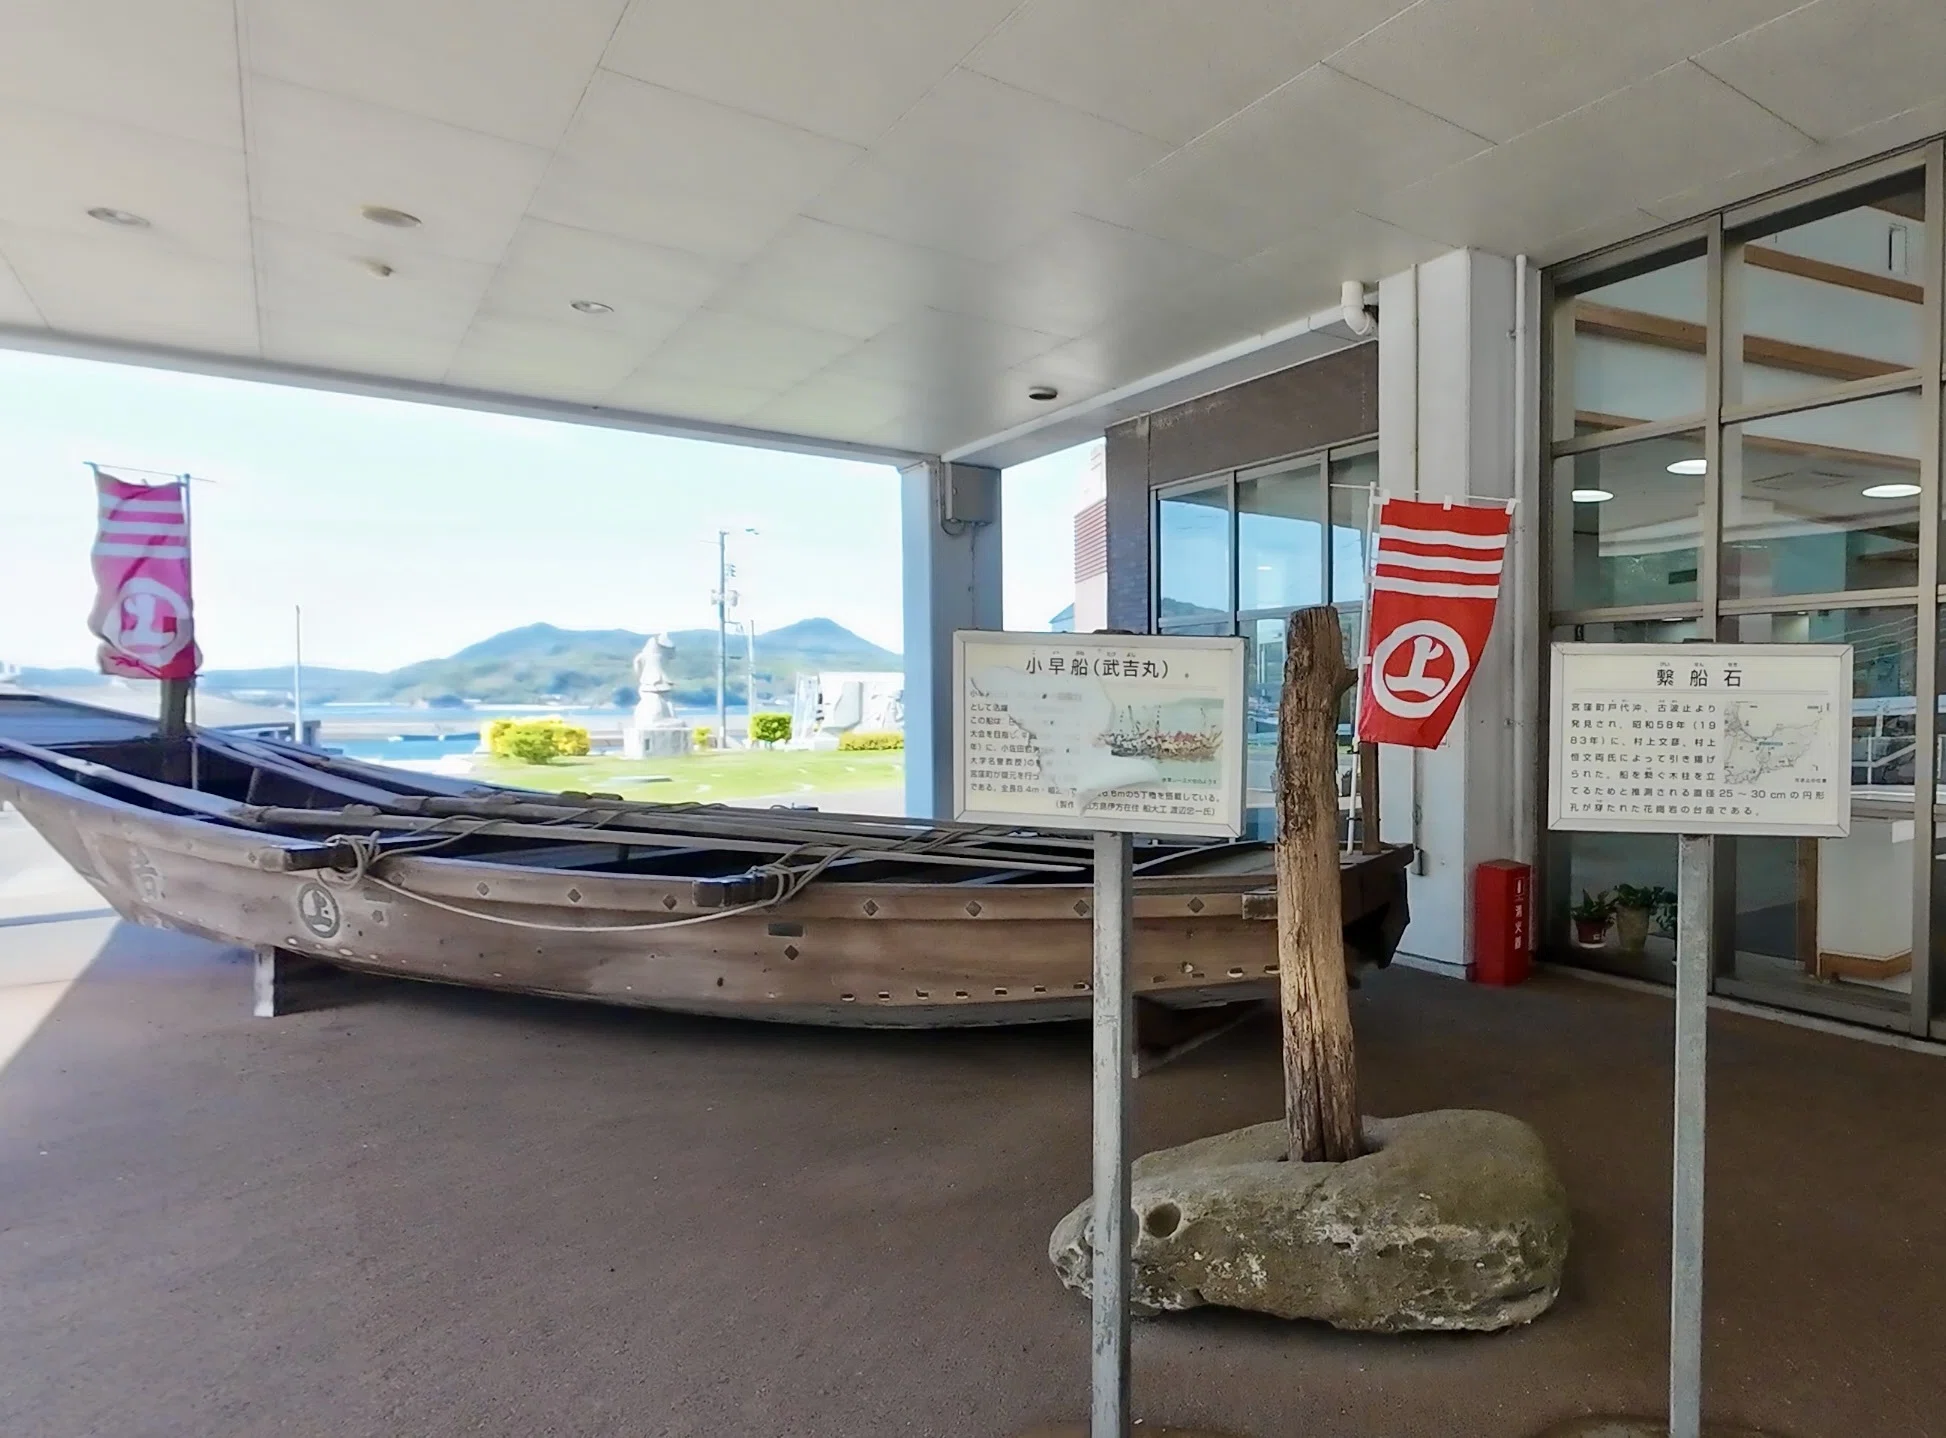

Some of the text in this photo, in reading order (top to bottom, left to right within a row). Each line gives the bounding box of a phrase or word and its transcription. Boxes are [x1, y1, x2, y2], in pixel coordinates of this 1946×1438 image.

[1026, 657, 1168, 679] 小早船(武吉丸)
